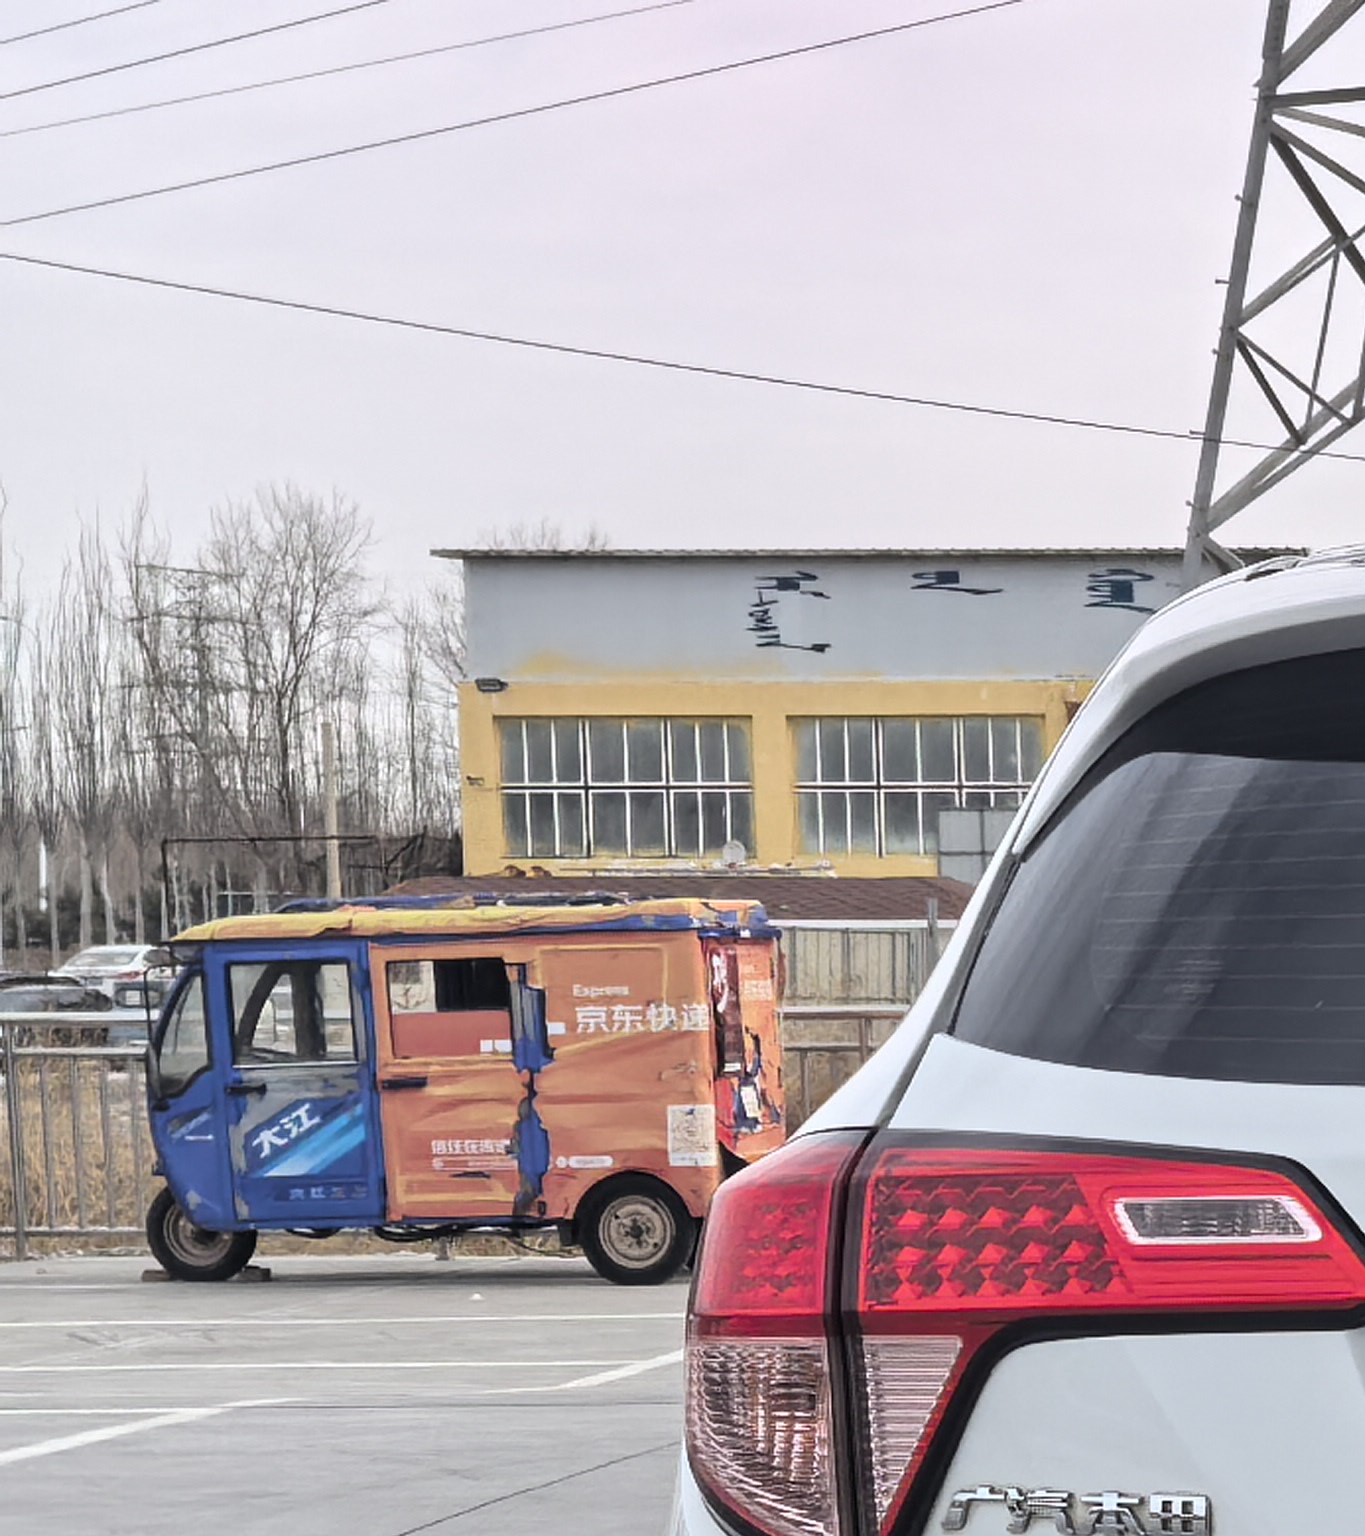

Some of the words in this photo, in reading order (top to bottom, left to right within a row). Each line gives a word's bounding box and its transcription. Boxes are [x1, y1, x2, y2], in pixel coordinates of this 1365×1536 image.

[575, 1003, 710, 1033] 京东快递
[251, 1102, 321, 1159] 大江
